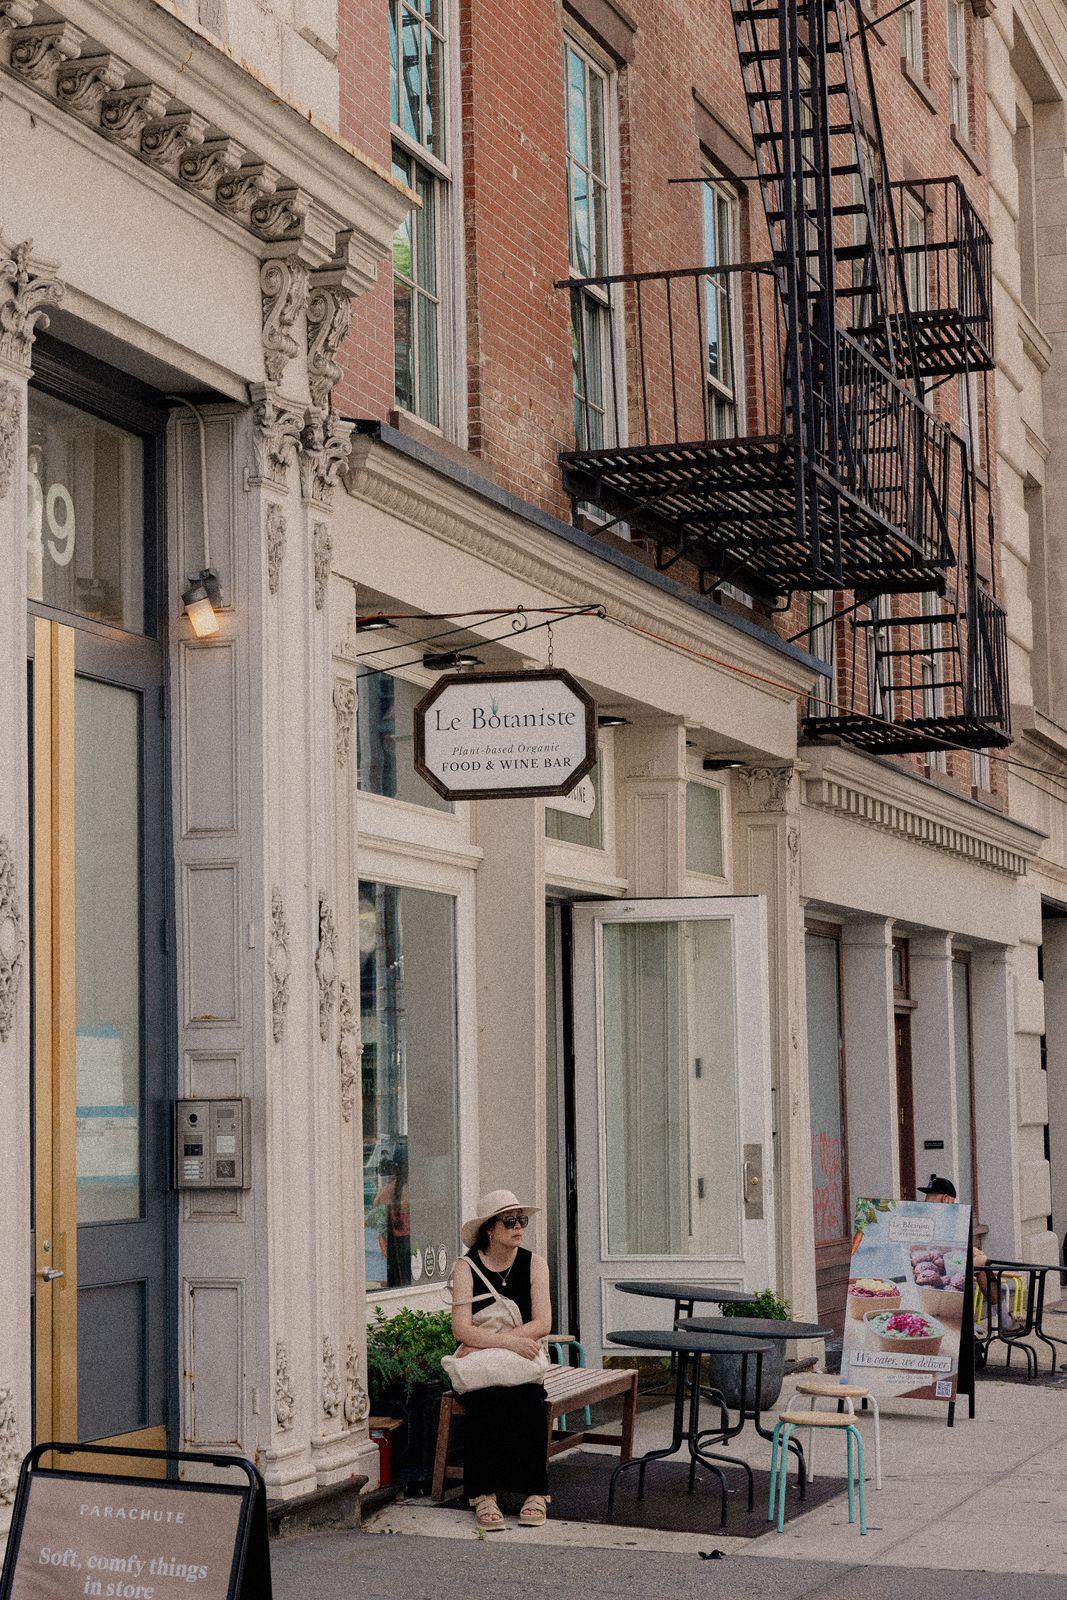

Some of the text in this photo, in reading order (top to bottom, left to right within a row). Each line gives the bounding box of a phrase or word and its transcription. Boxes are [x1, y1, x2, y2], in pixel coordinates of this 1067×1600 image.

[435, 709, 461, 731] Le
[452, 742, 560, 756] Plant-based Organic
[442, 756, 572, 772] FOOD & WINE BAR
[856, 1352, 872, 1363] We
[901, 1358, 915, 1367] we
[917, 1357, 948, 1369] deliver
[79, 1503, 185, 1525] PARACHUTE
[39, 1547, 208, 1582] Soft, comfy things
[84, 1575, 155, 1599] in store
